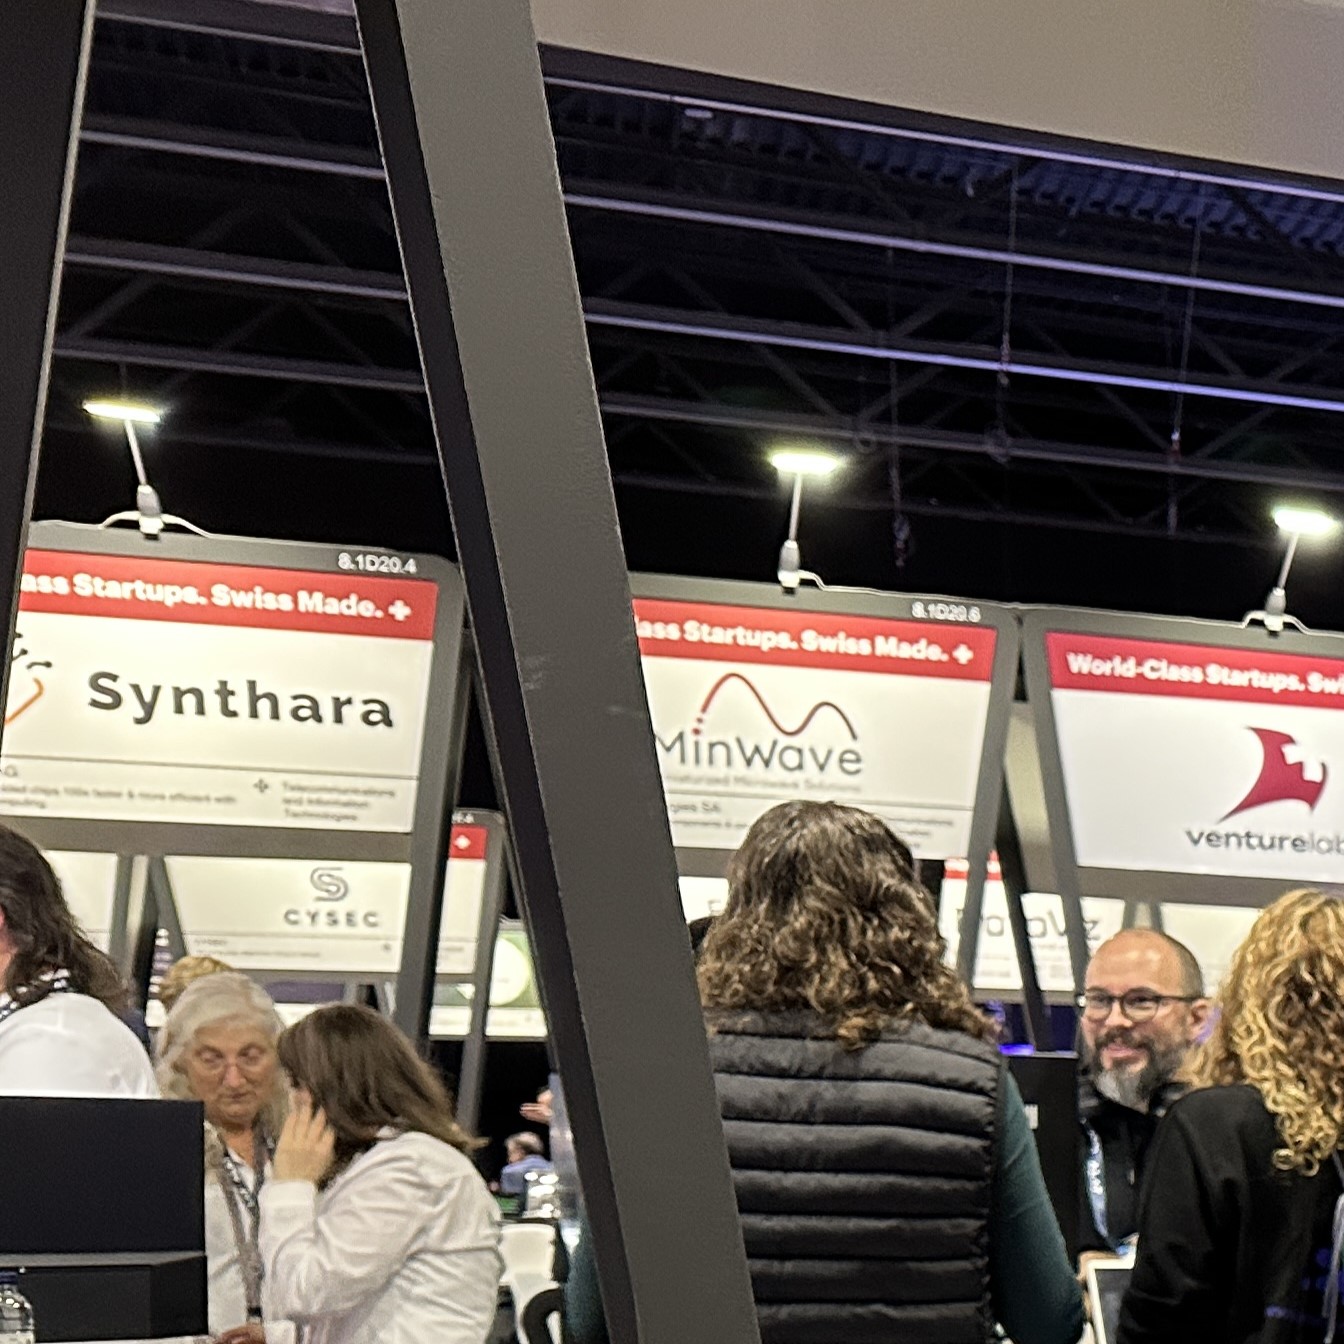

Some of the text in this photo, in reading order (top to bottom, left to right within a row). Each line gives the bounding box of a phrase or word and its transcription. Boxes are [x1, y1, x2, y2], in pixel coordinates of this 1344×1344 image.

[73, 572, 207, 608] Startups.
[212, 584, 294, 612] Swiss
[298, 590, 384, 618] Made.
[684, 620, 798, 651] Startups.
[801, 629, 872, 655] Swiss
[874, 635, 948, 661] Made.
[1066, 652, 1203, 684] World-Class
[1205, 663, 1304, 694] Startups.
[88, 671, 393, 728] Synthara
[284, 908, 380, 928] CYSEC
